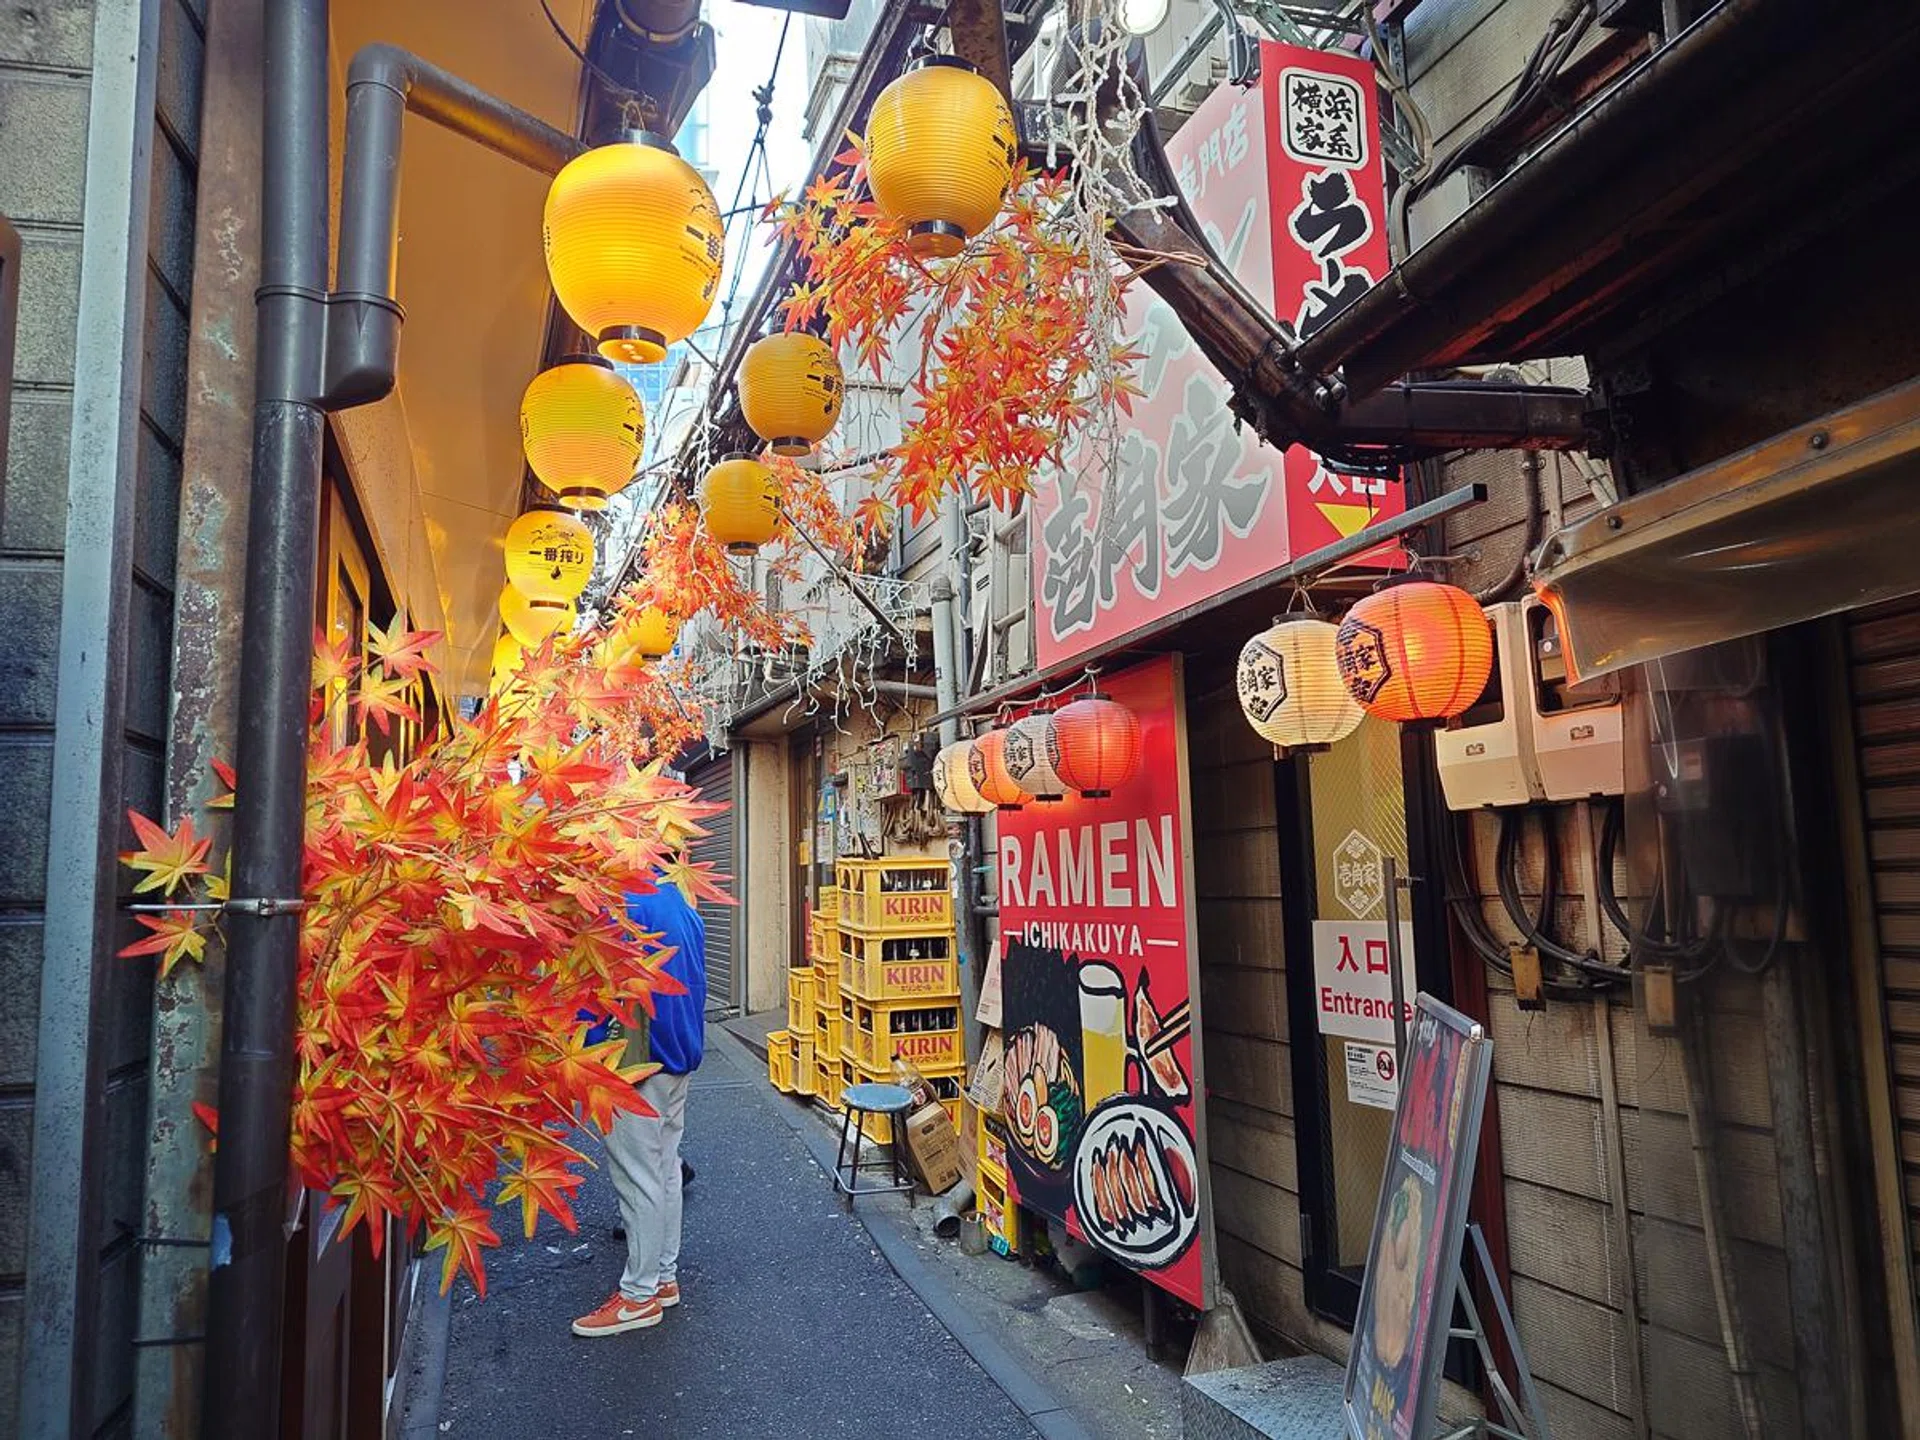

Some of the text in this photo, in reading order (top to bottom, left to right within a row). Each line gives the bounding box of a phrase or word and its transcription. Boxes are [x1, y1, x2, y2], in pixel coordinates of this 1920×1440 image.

[1292, 81, 1353, 122] 横浜
[1295, 116, 1353, 157] 家系
[528, 547, 584, 565] 一番搾り
[1000, 815, 1177, 908] RAMEN
[885, 895, 944, 915] KIRIN
[1022, 920, 1144, 957] ICHIKAKUYA
[1335, 935, 1390, 975] 入口
[887, 964, 945, 986] KIRIN
[896, 1035, 953, 1056] KIRIN
